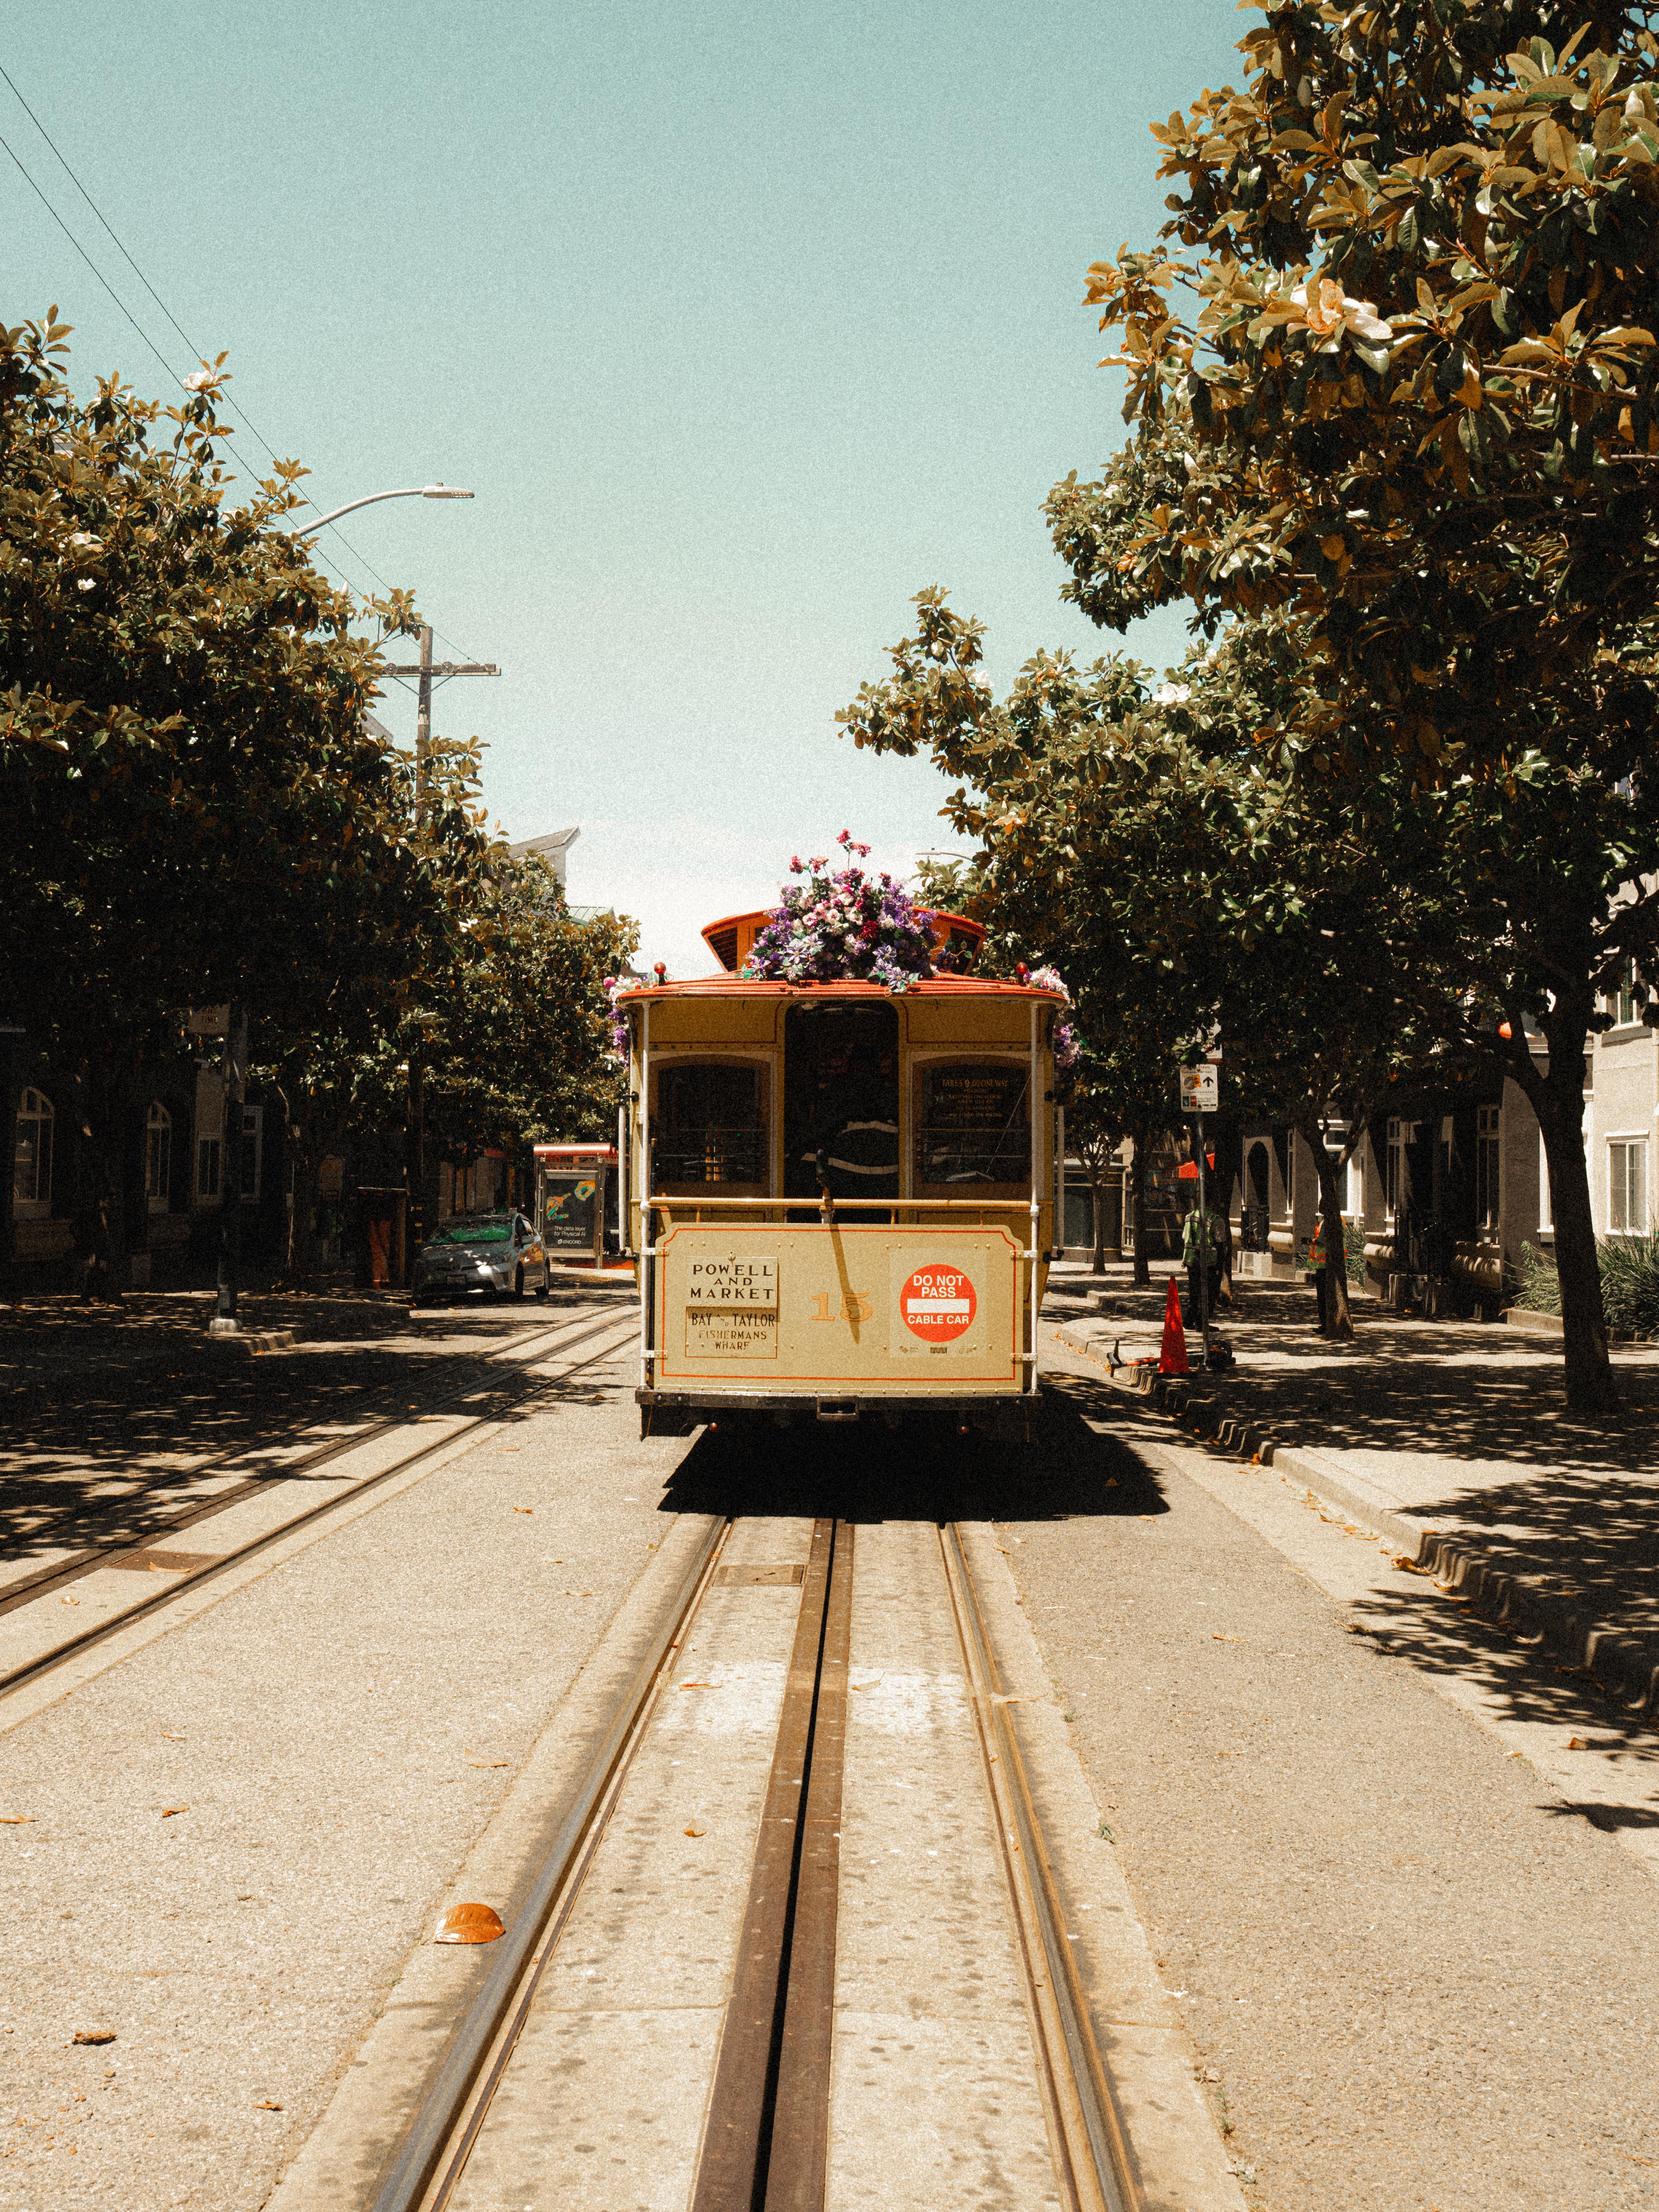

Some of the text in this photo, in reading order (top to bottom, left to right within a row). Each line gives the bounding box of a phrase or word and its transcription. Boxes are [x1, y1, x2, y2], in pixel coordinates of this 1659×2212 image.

[693, 1264, 773, 1276] POWELL
[713, 1277, 752, 1285] AND
[913, 1275, 964, 1286] DO NOT
[690, 1287, 774, 1299] MARKET
[921, 1286, 956, 1298] PASS
[811, 1292, 873, 1322] 15
[692, 1313, 775, 1327] BAY AND TAYLOR
[908, 1315, 969, 1324] CABLE CAR
[698, 1330, 767, 1340] FISHERMANS
[715, 1341, 750, 1350] WHARF
